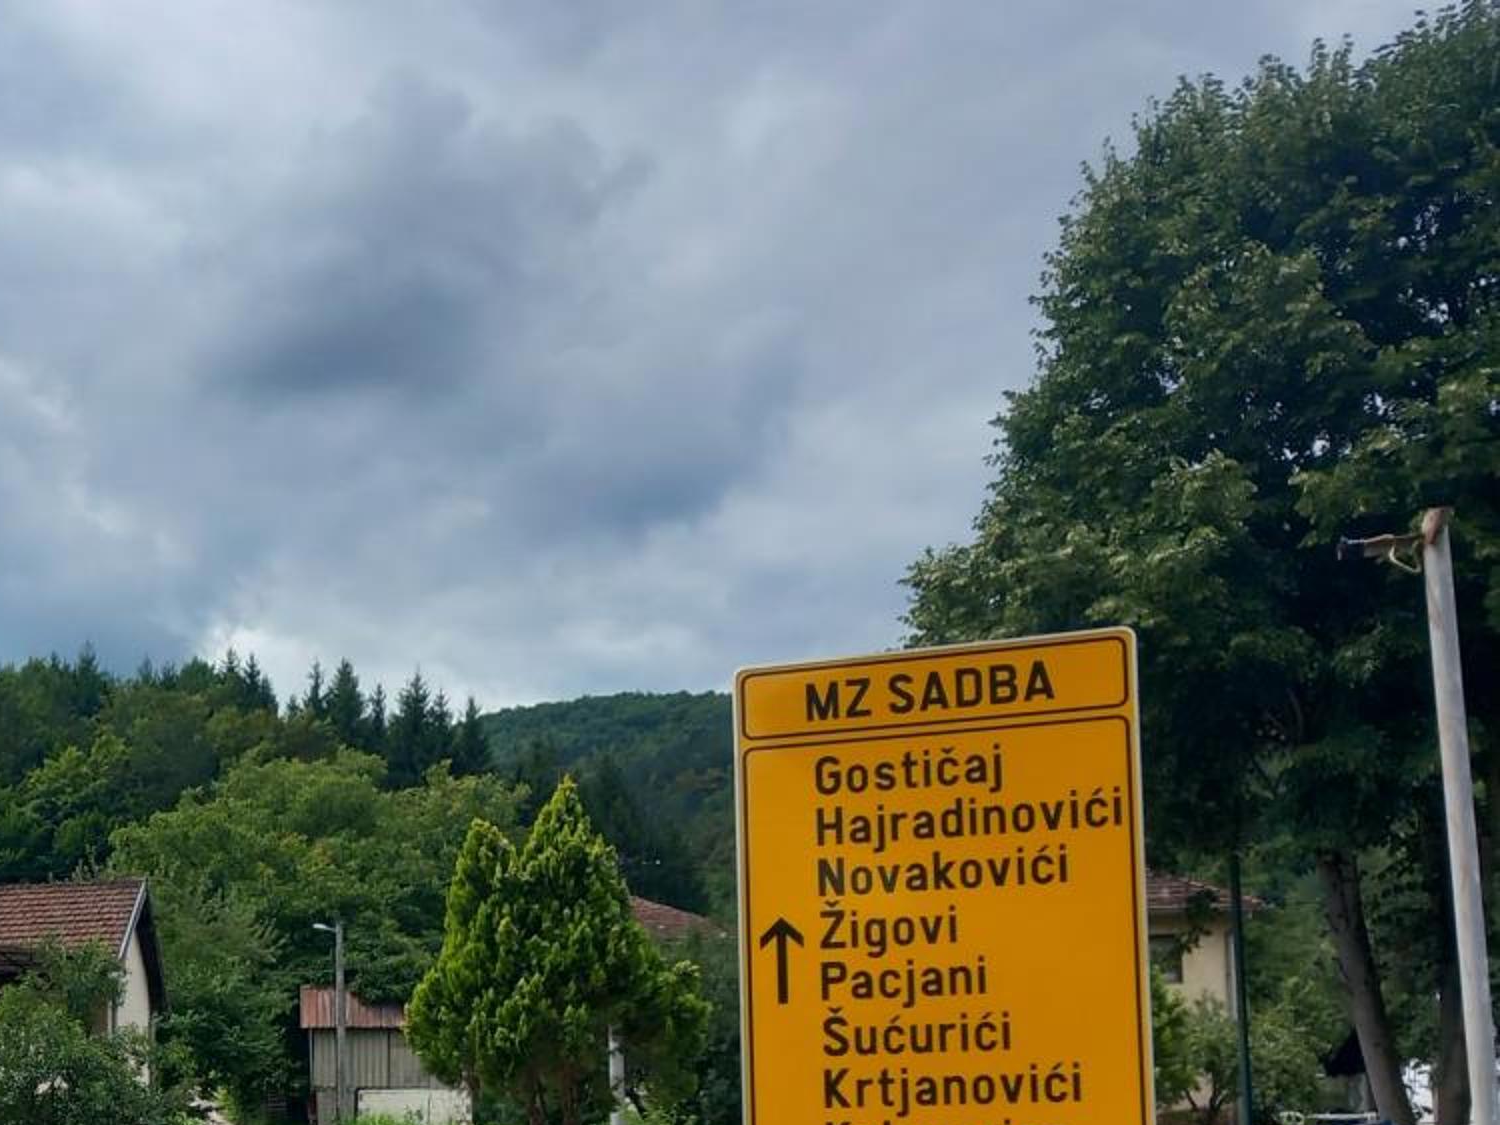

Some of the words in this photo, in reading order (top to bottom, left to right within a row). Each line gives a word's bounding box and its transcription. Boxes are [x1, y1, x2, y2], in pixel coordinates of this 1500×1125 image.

[805, 677, 873, 722] MZ
[888, 659, 1056, 715] SADBA
[814, 743, 1004, 796] Gostičaj
[816, 786, 1124, 854] Hajradinovići
[817, 843, 1069, 897] Novakovići
[819, 900, 958, 959] Žigovi
[820, 955, 988, 1009] Pacjani
[823, 1007, 1012, 1057] Šućurići
[823, 1062, 1082, 1118] Krtjanovići
